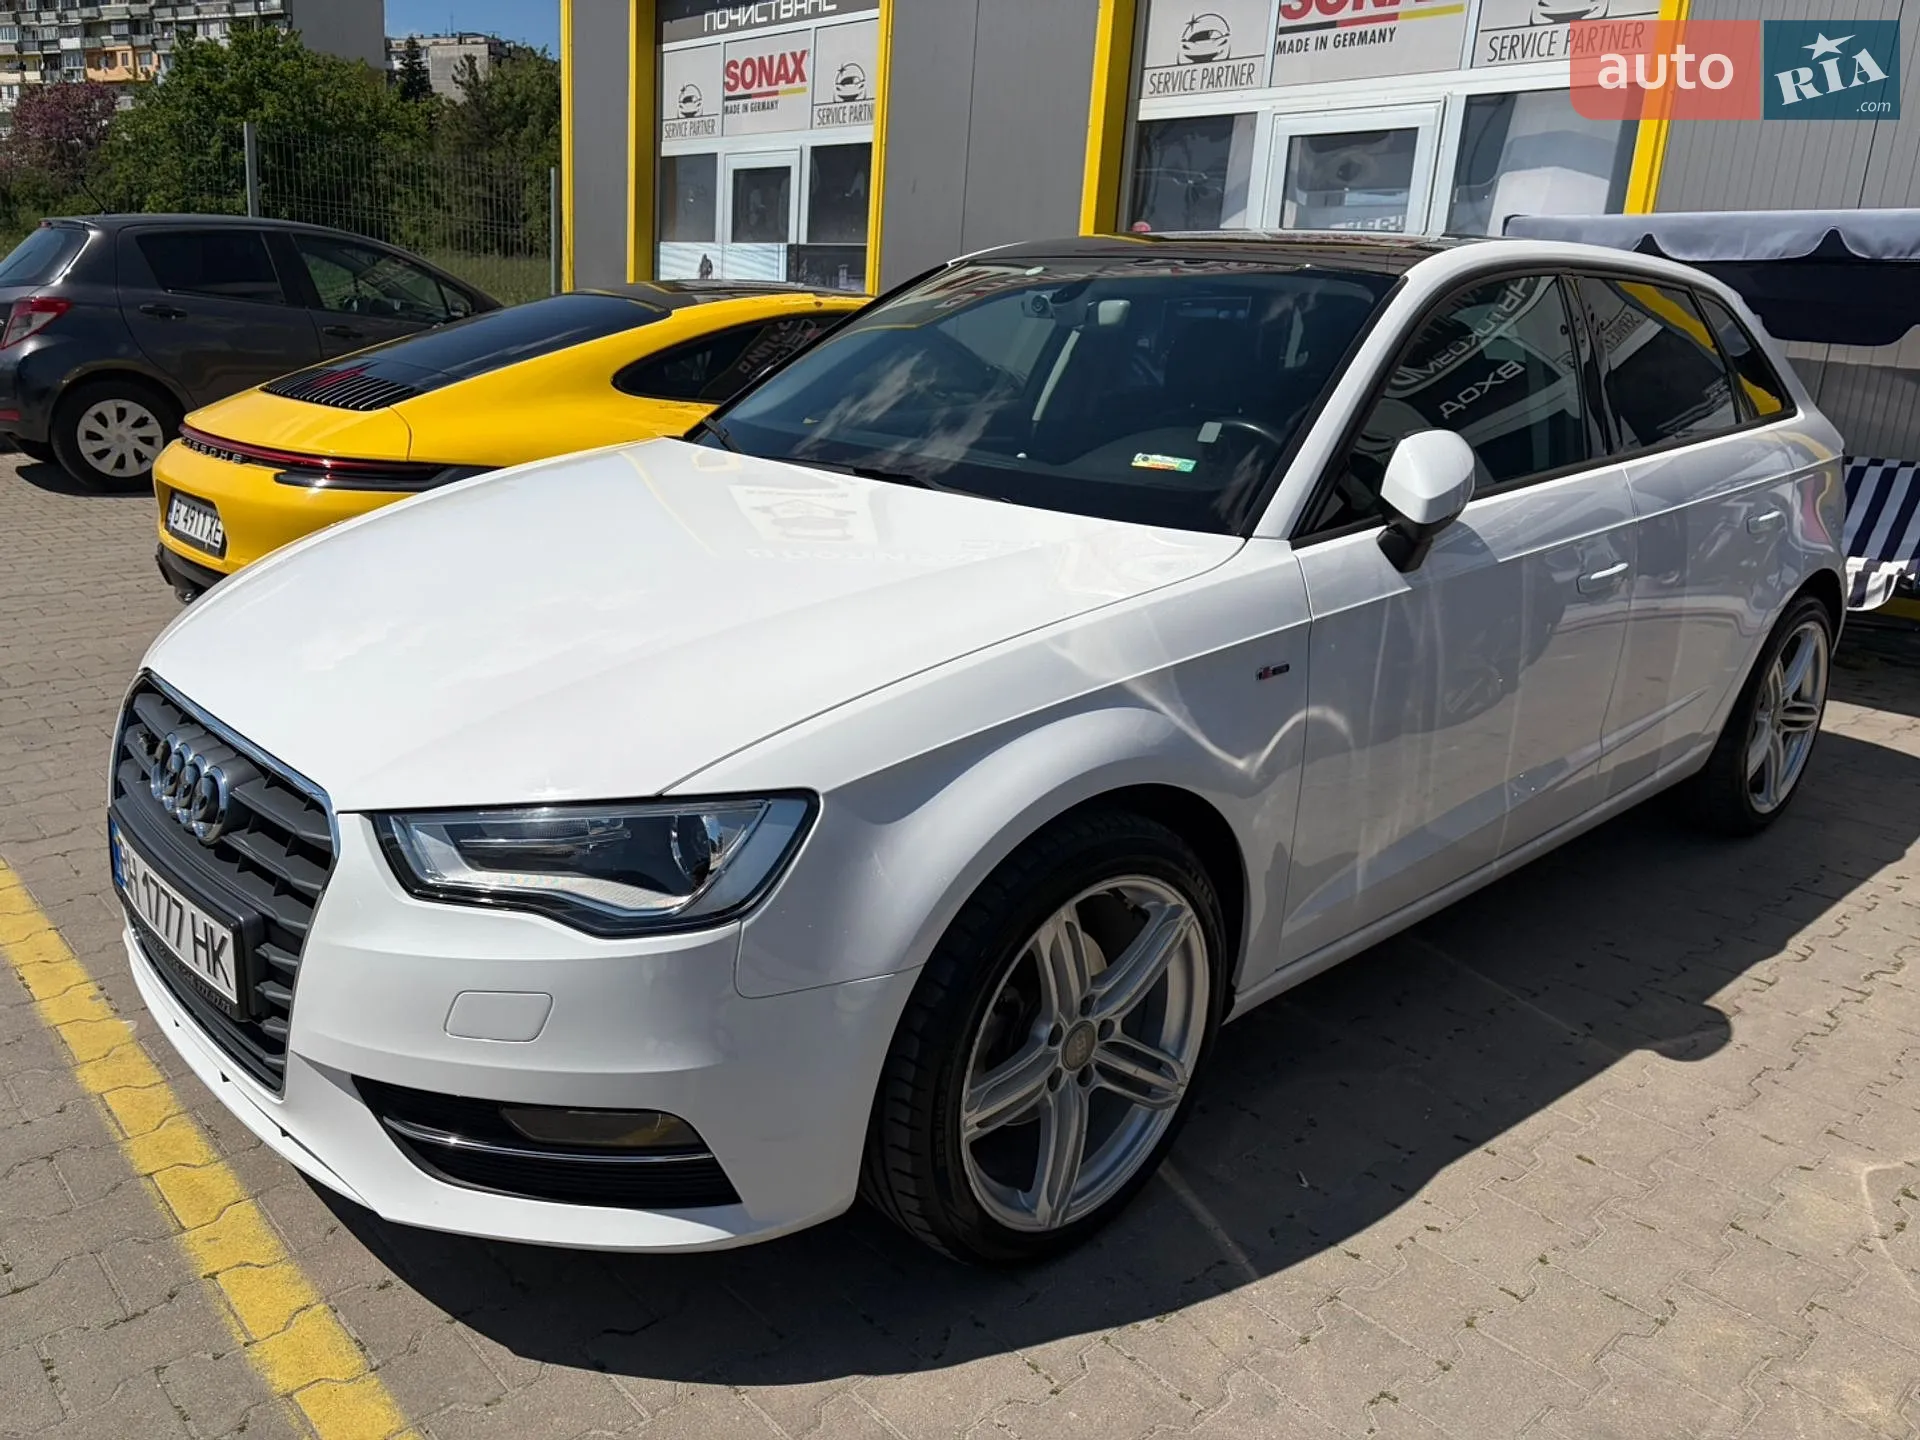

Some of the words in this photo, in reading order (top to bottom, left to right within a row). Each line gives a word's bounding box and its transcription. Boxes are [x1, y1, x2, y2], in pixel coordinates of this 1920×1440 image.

[1276, 36, 1310, 55] MADE
[1314, 34, 1328, 51] IN
[1333, 27, 1397, 49] GERMANY
[1487, 30, 1559, 62] SERVICE
[1563, 21, 1645, 56] PARTNER
[724, 50, 809, 92] SONAX
[1149, 69, 1197, 94] SERVICE
[1200, 63, 1255, 89] PARTNER
[742, 102, 749, 113] IN
[750, 100, 779, 113] GERMANY
[817, 106, 848, 126] SERVICE
[664, 122, 688, 138] SERVICE
[689, 119, 715, 136] PARTNER
[142, 869, 184, 949] 1777
[190, 910, 233, 990] HK
